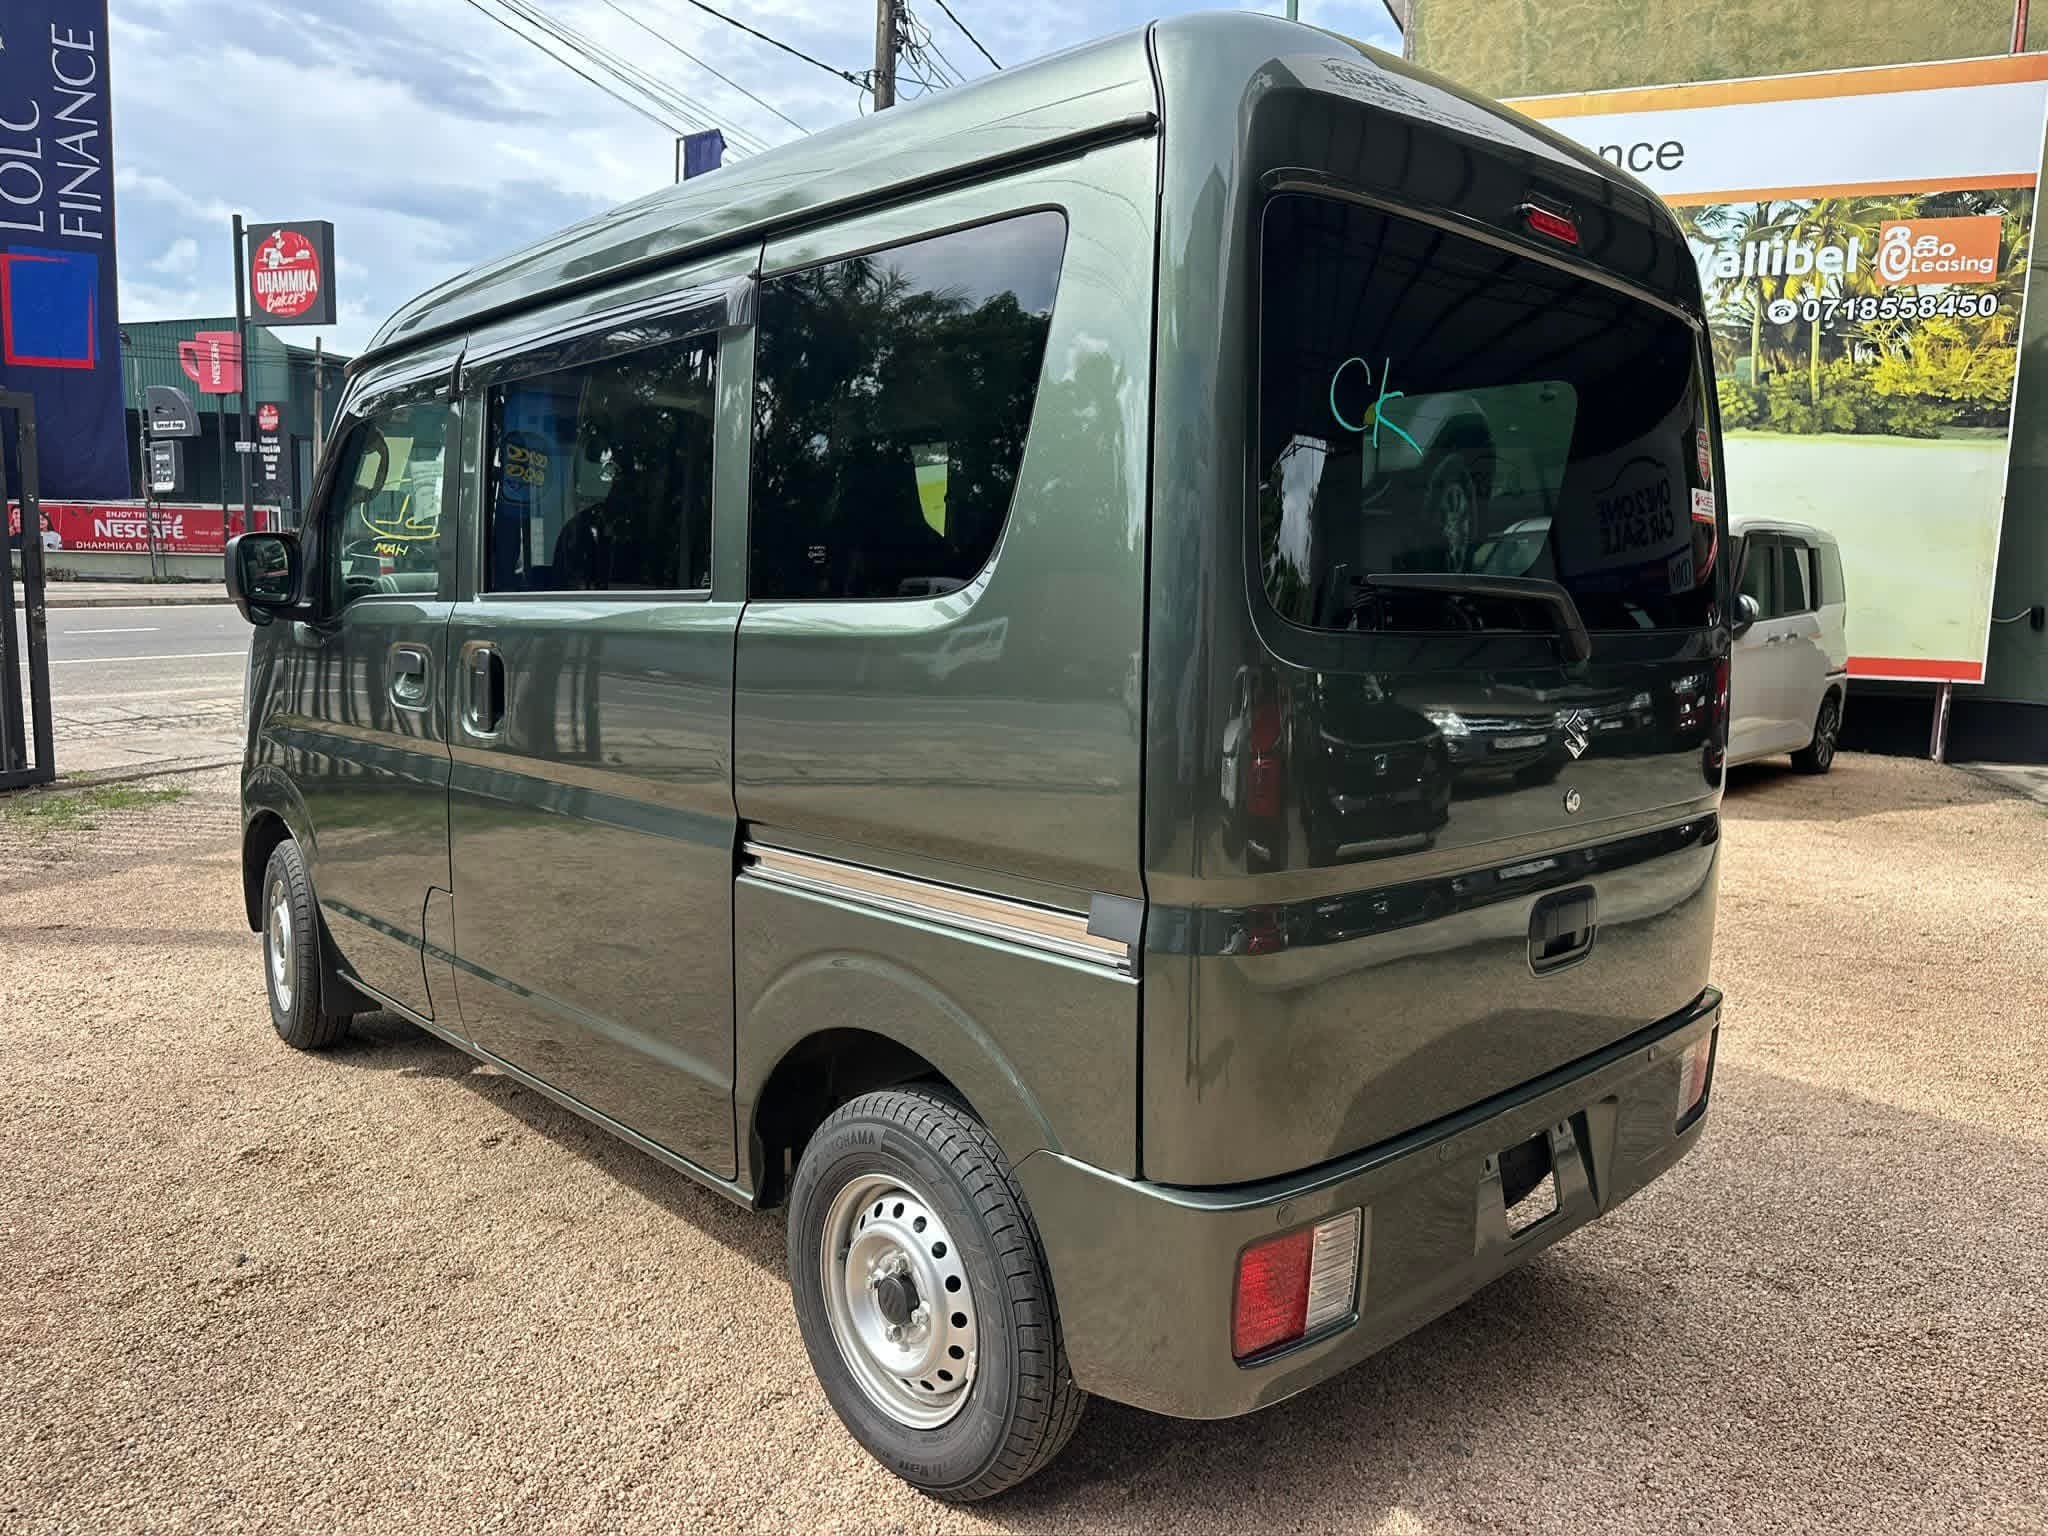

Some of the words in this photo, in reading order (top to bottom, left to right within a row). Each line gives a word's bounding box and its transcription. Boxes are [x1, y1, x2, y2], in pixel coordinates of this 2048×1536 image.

[51, 23, 103, 239] FINANCE
[0, 100, 44, 232] LOLC
[1911, 256, 1993, 274] Leasing
[257, 269, 317, 293] DHAMMIKA
[1801, 293, 1998, 322] 0718558450
[76, 541, 133, 550] DHAMMIKA
